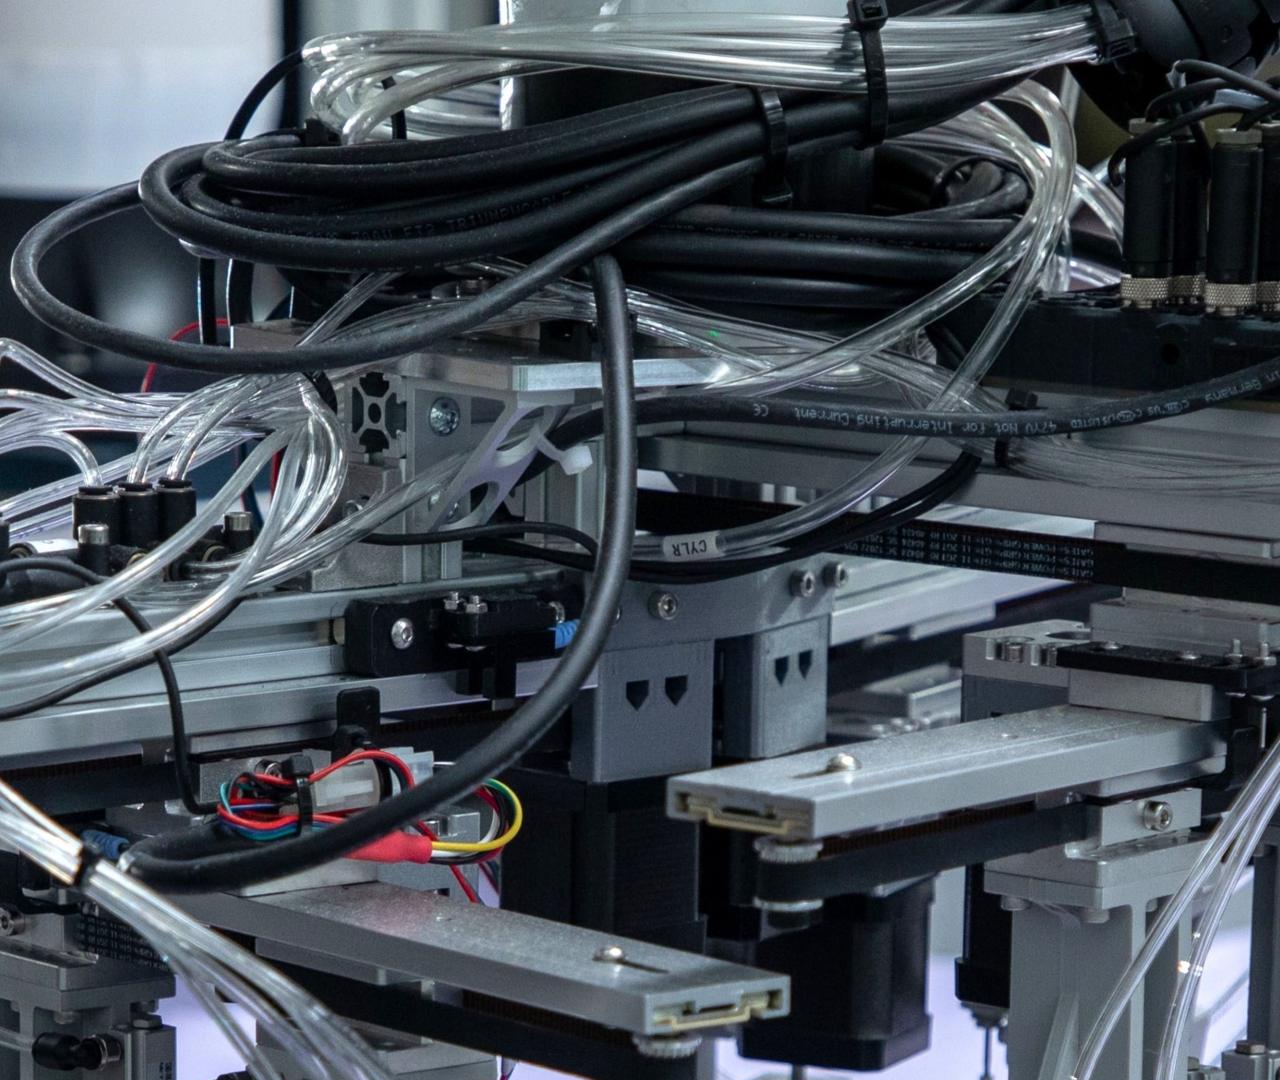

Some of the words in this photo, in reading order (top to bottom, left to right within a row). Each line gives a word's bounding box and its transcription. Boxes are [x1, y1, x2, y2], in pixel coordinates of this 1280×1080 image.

[1205, 378, 1263, 403] Germany
[793, 407, 850, 426] Current
[856, 412, 953, 431] Interrupting
[961, 420, 986, 434] for
[993, 421, 1018, 434] Not
[671, 539, 707, 557] CYLR
